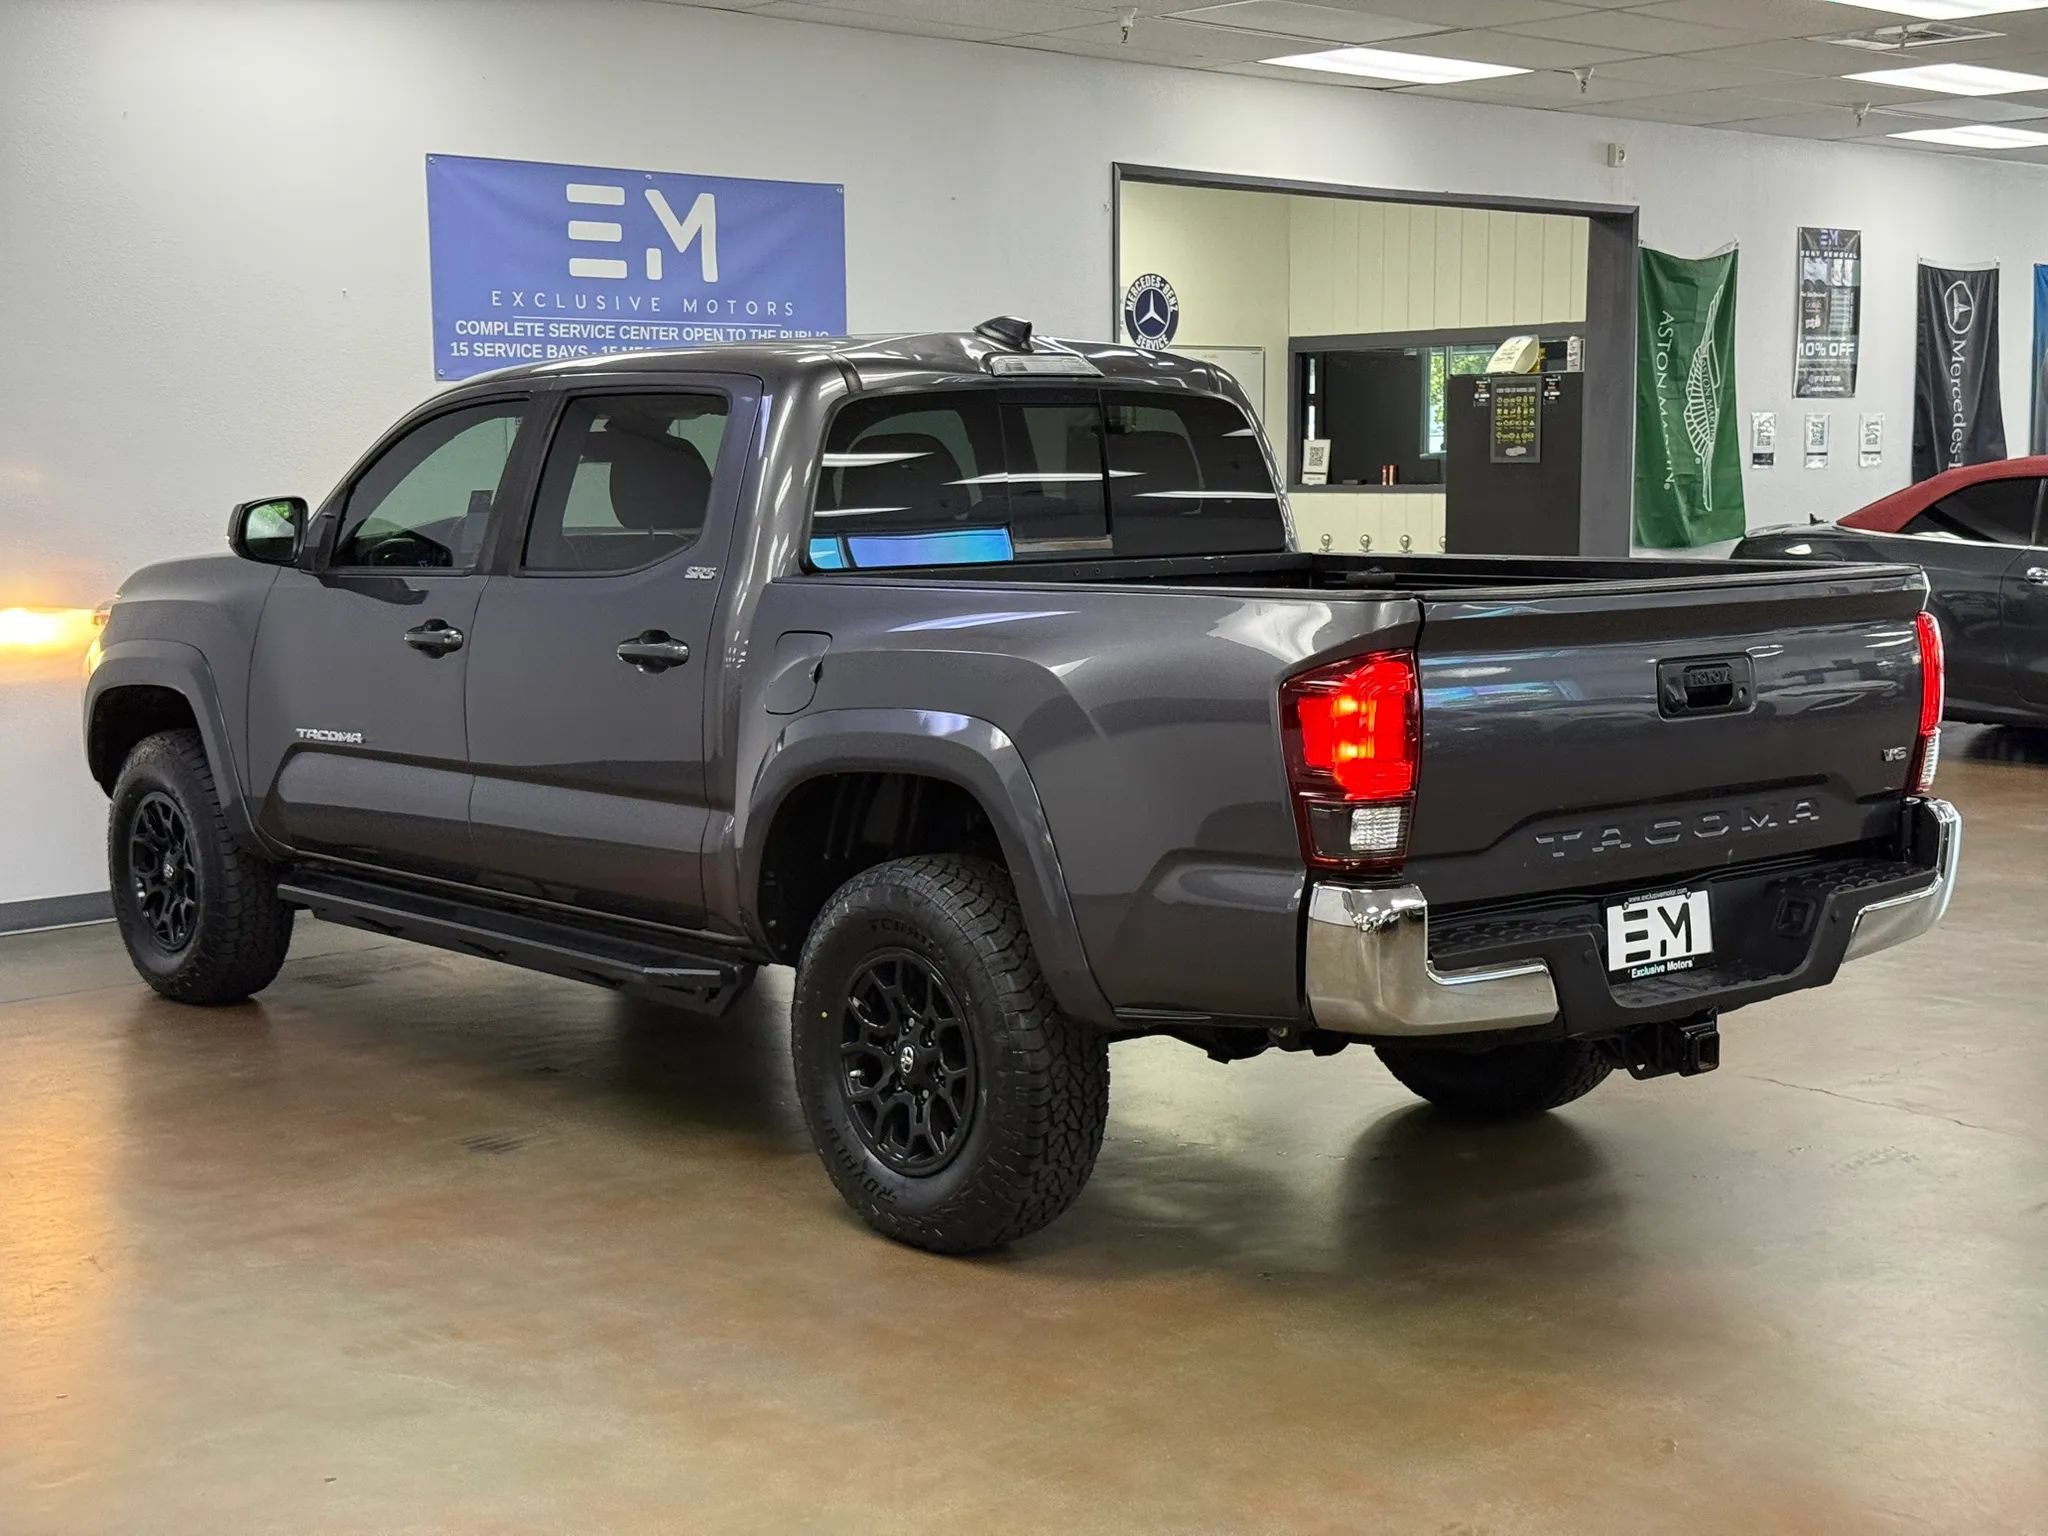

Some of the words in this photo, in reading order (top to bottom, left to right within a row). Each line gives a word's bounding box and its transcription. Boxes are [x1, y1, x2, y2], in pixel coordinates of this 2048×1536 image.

[566, 182, 719, 283] EM
[492, 290, 661, 313] EXCLUSIVE
[683, 298, 794, 317] MOTORS
[455, 320, 545, 337] COMPLETE
[549, 323, 616, 339] SERVICE
[619, 325, 679, 342] CENTER
[682, 327, 724, 342] OPEN
[726, 328, 747, 341] TO
[450, 342, 469, 356] 15
[473, 343, 543, 358] SERVICE
[547, 344, 588, 359] BAYS
[1656, 310, 1675, 389] ASTON
[1799, 342, 1826, 356] 10%
[1829, 342, 1855, 356] OFF
[295, 728, 363, 744] TACOMA
[1535, 800, 1820, 858] TACOMA
[1623, 902, 1693, 963] EM
[1631, 963, 1666, 979] Exclusive
[1667, 959, 1693, 972] Motors
